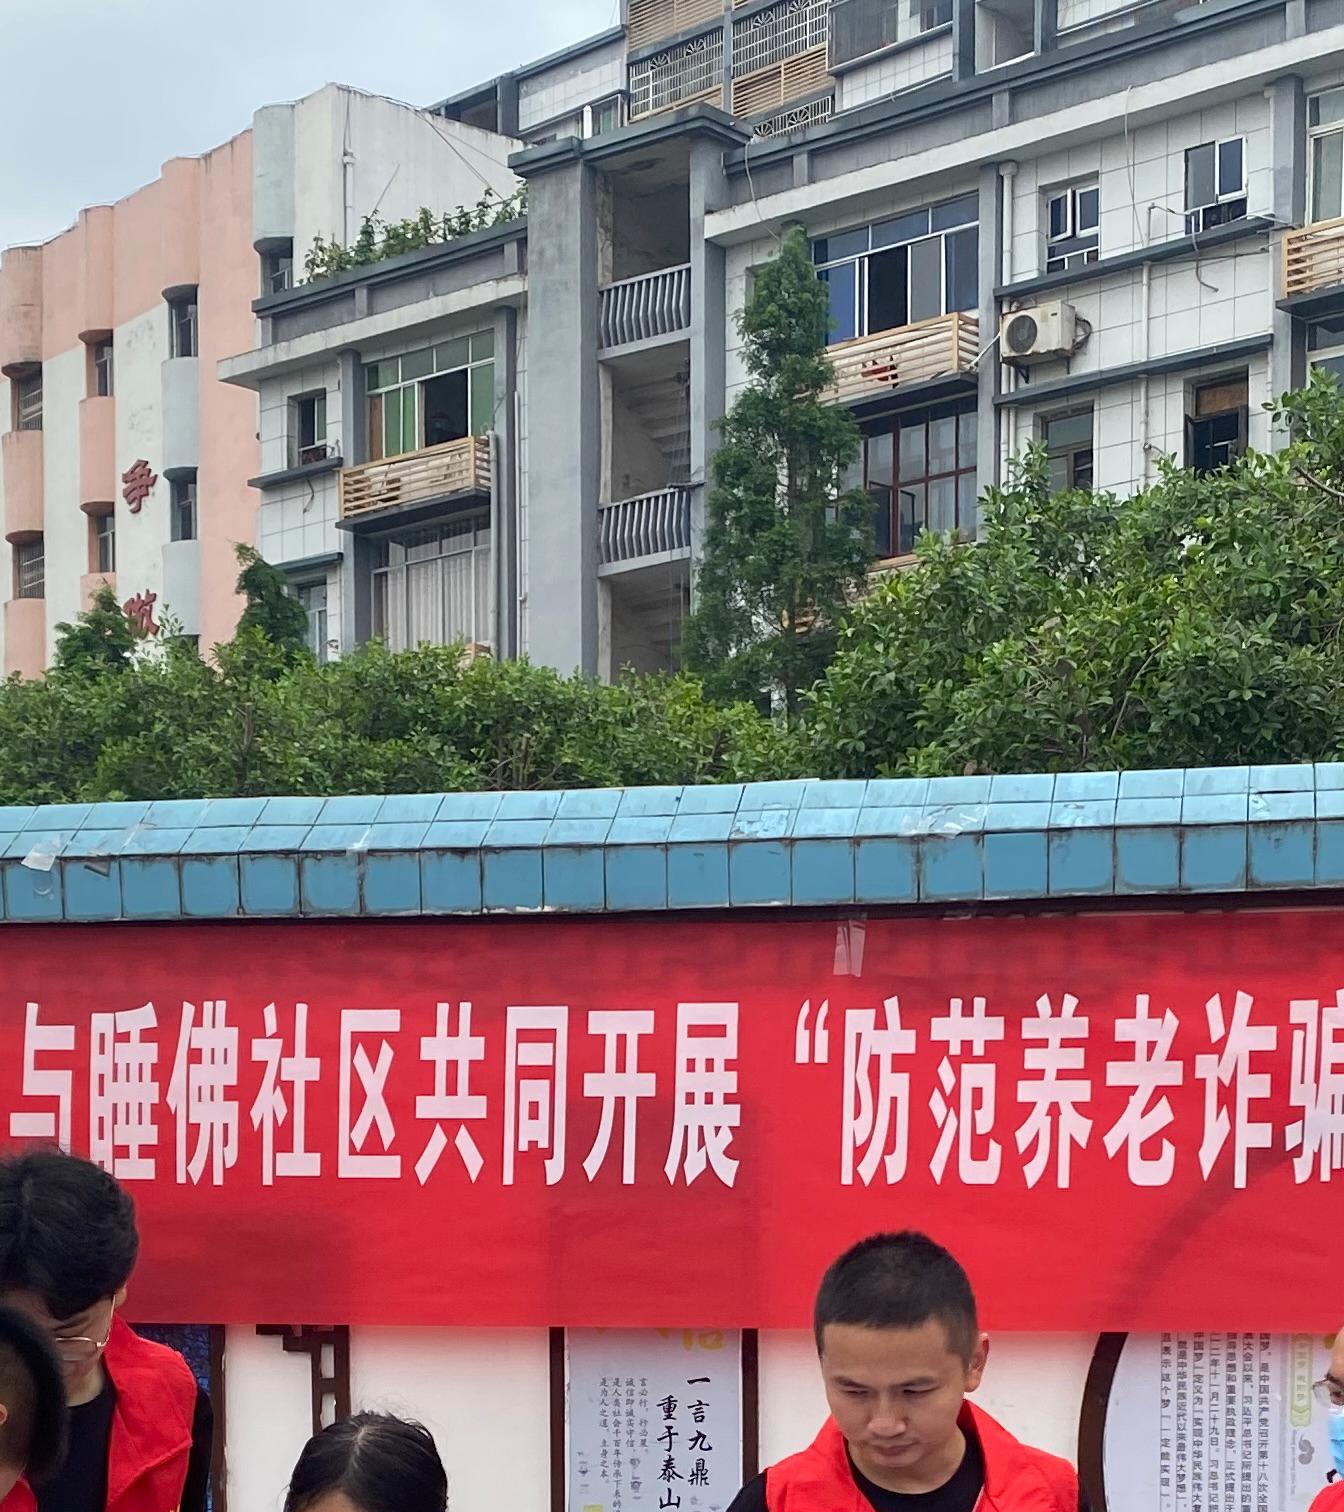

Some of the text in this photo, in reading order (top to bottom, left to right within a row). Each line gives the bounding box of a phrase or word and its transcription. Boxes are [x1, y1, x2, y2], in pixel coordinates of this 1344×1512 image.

[656, 1395, 684, 1509] 重于泰山
[687, 1376, 713, 1487] 一言九鼎
